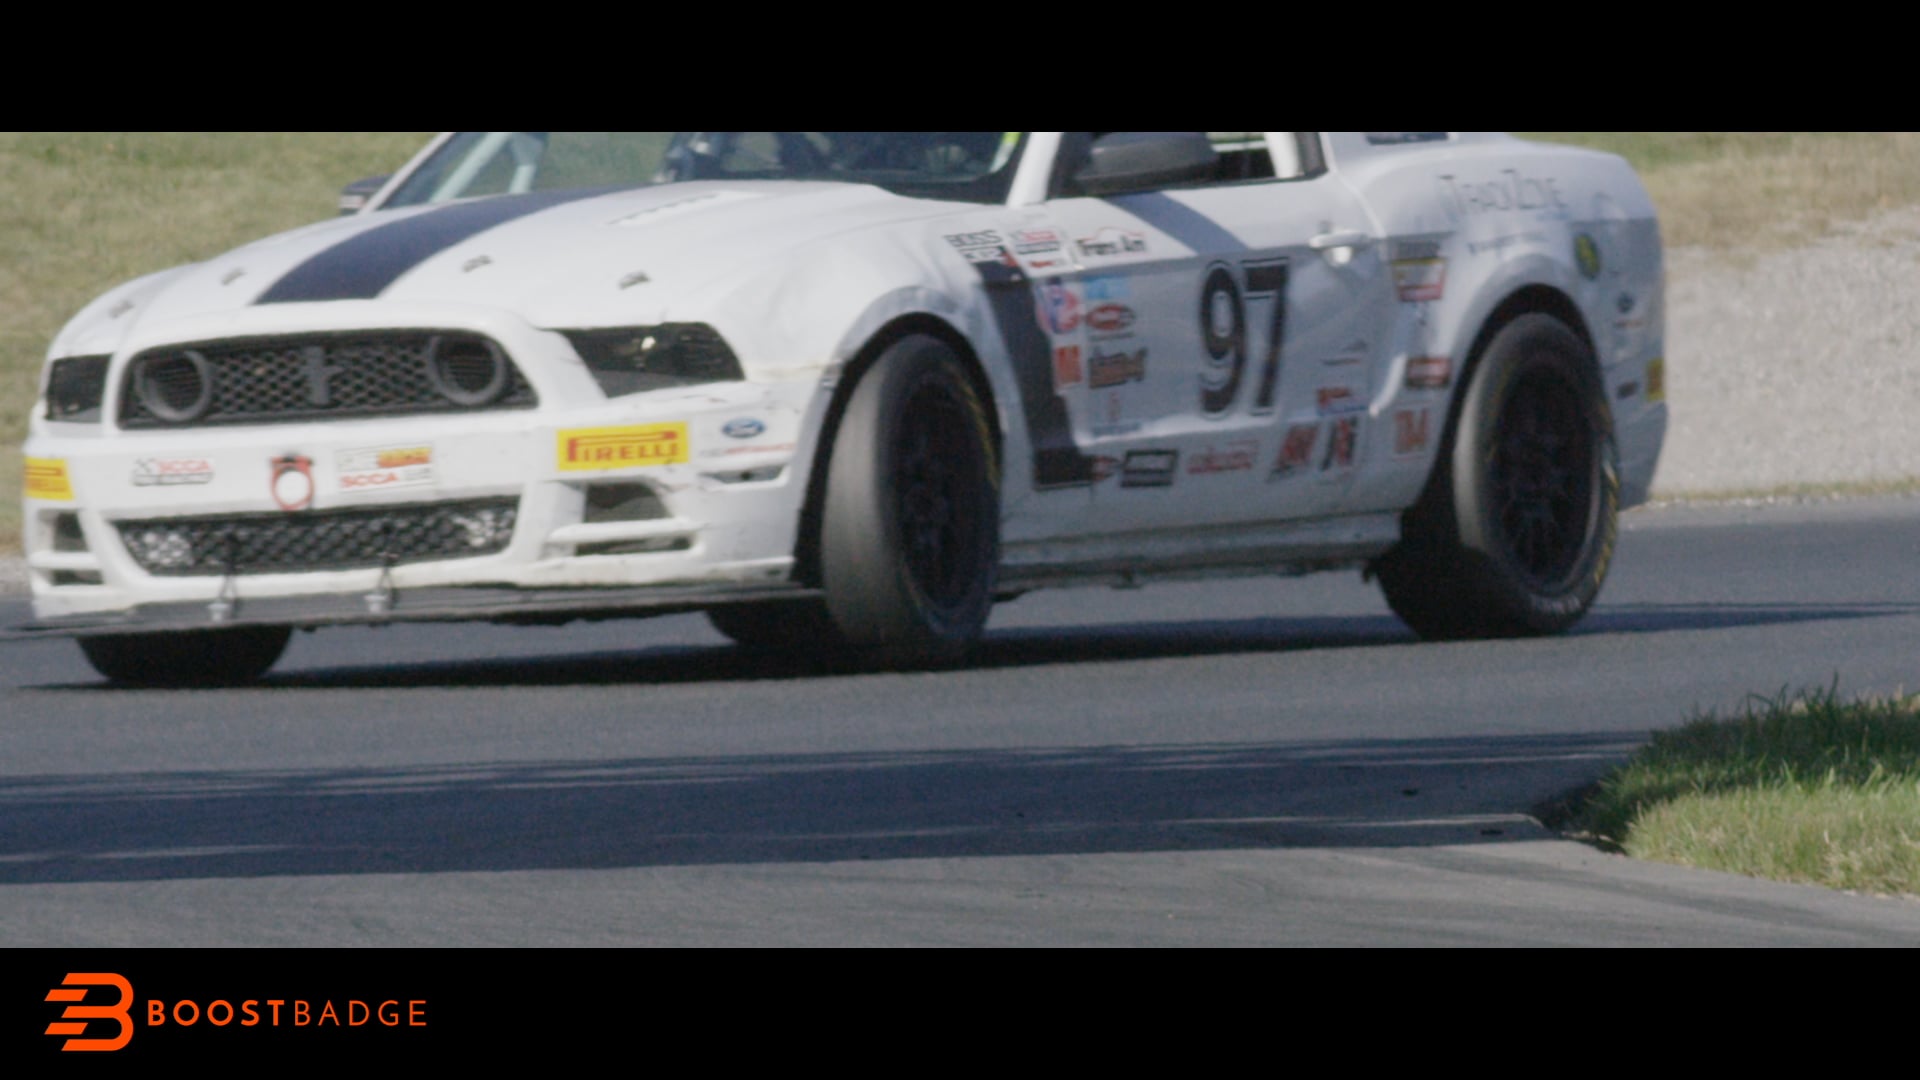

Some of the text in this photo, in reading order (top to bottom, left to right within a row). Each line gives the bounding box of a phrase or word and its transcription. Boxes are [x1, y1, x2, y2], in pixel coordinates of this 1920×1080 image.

[1197, 256, 1290, 420] 97
[567, 430, 680, 463] PIRELLI
[341, 472, 399, 489] SCCA
